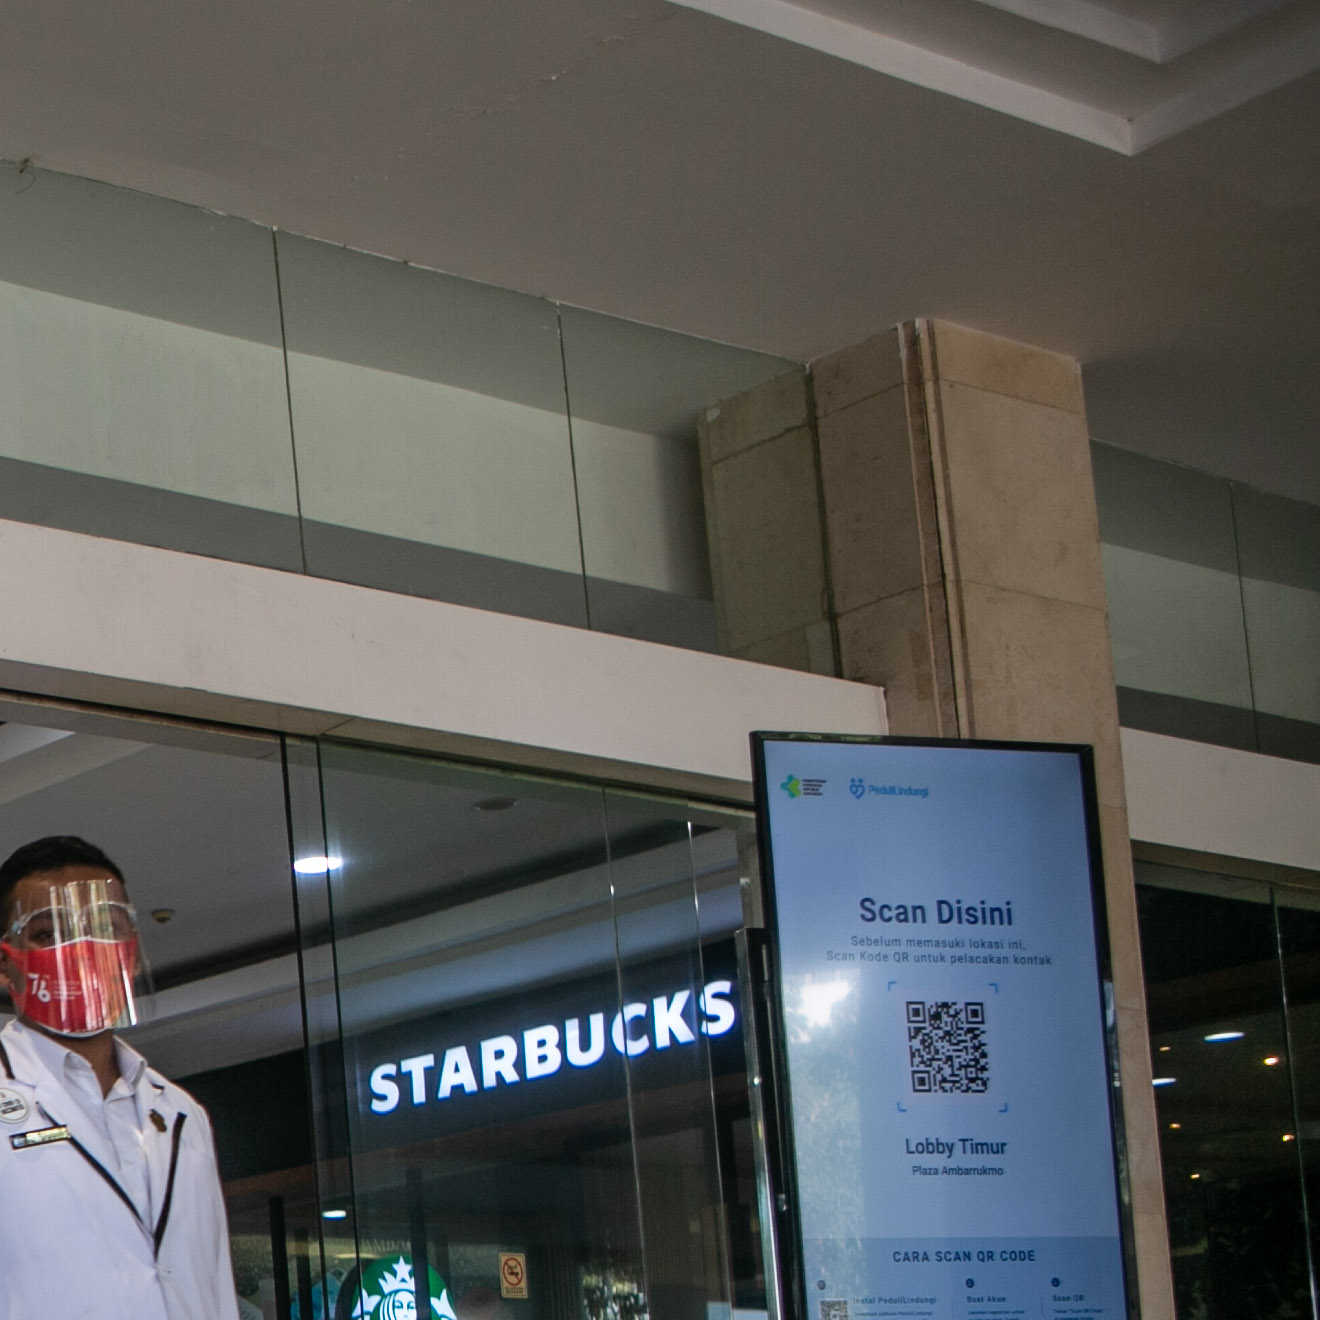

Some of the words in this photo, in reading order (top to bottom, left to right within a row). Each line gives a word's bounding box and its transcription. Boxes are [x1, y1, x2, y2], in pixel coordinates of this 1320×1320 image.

[859, 897, 926, 924] Scan
[936, 898, 1013, 926] Disini
[850, 935, 901, 947] Sebelum
[906, 937, 965, 949] memasuki
[969, 938, 1004, 950] lokasi
[826, 950, 854, 962] Scan
[859, 951, 888, 963] Kode
[893, 952, 910, 963] QR
[914, 952, 946, 964] untuk
[950, 953, 1009, 967] pelacakan
[1013, 954, 1052, 966] kontak
[369, 980, 737, 1116] STARBUCKS
[905, 1137, 955, 1159] Lobby
[958, 1137, 1007, 1155] Timur
[912, 1165, 938, 1176] Plaza
[941, 1165, 1004, 1177] Ambarrukmo
[892, 1250, 930, 1263] CARA
[935, 1250, 971, 1262] SCAN
[976, 1250, 995, 1263] QR
[999, 1249, 1035, 1262] CODE
